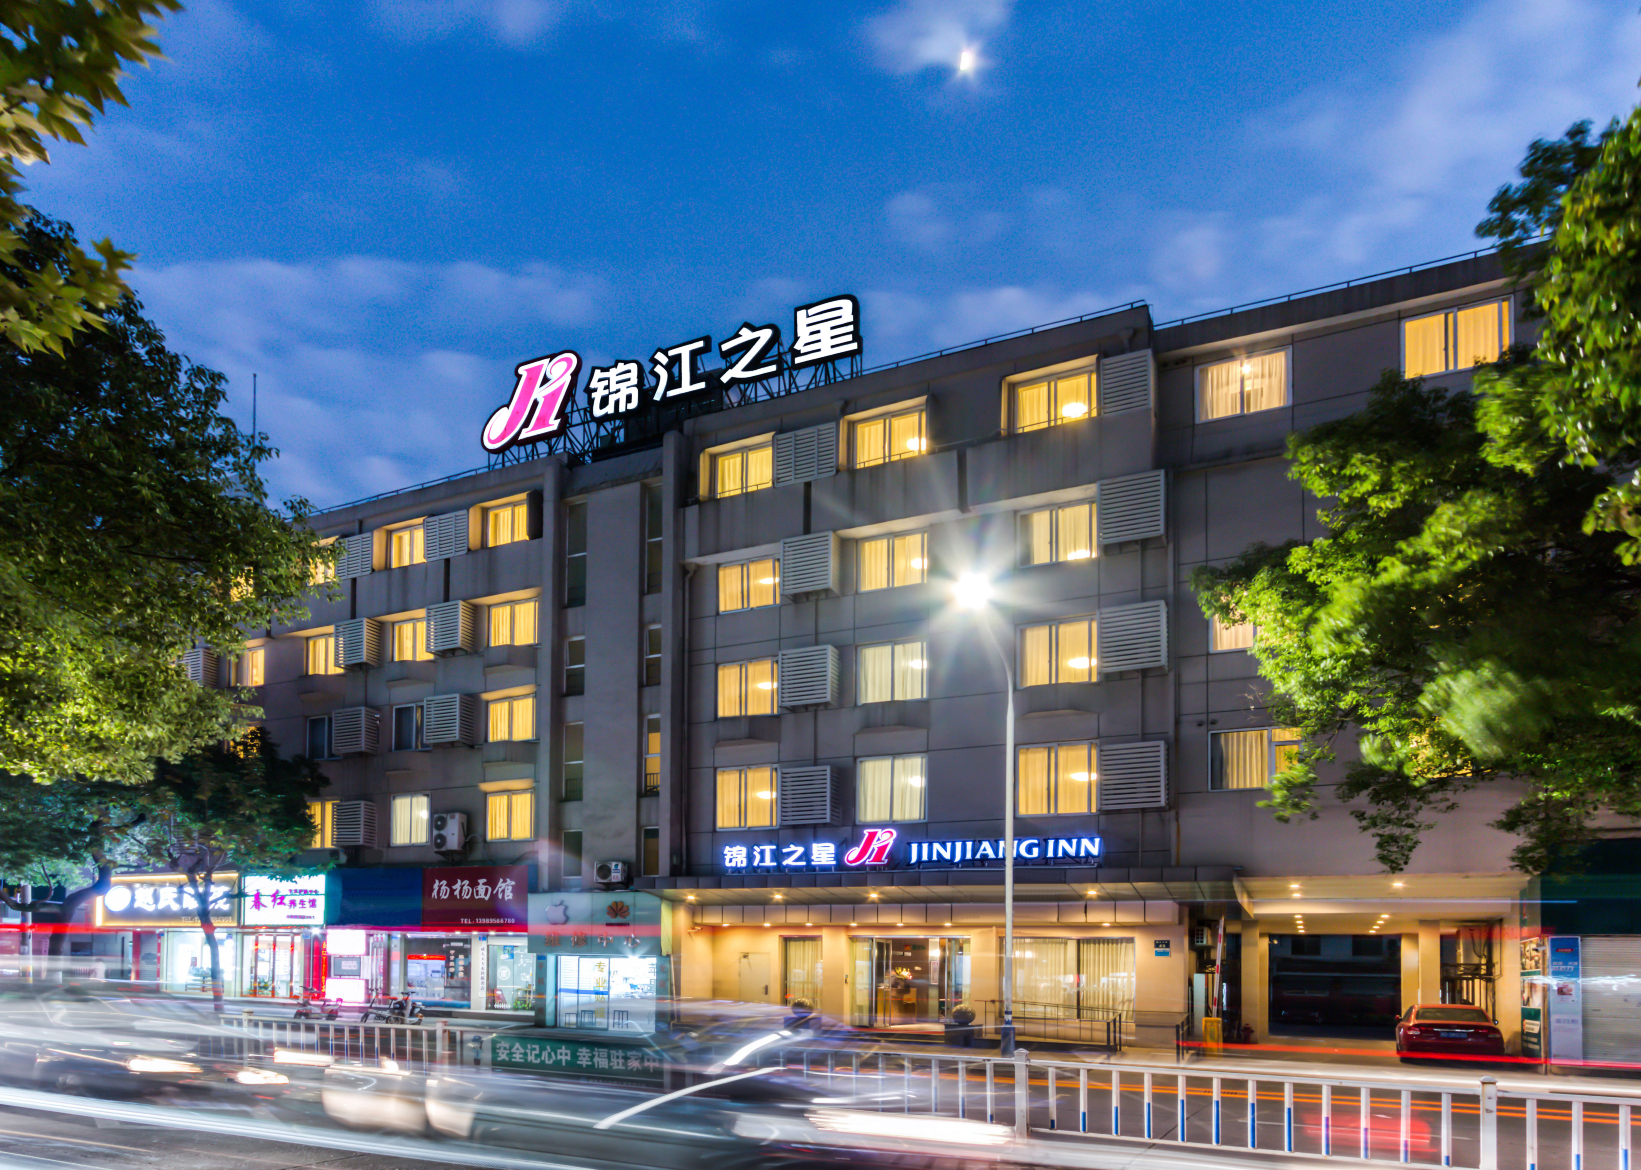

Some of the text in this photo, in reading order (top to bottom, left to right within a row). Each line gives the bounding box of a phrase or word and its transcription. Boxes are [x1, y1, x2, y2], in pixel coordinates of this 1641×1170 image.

[590, 299, 858, 416] 锦江之星
[723, 842, 836, 867] 锦江之星
[911, 837, 1100, 864] JINJIANG INN
[544, 931, 641, 948] 维修中心
[594, 961, 606, 1019] 专业贴膜
[495, 1041, 661, 1073] 安全记心中 幸福驻家中
